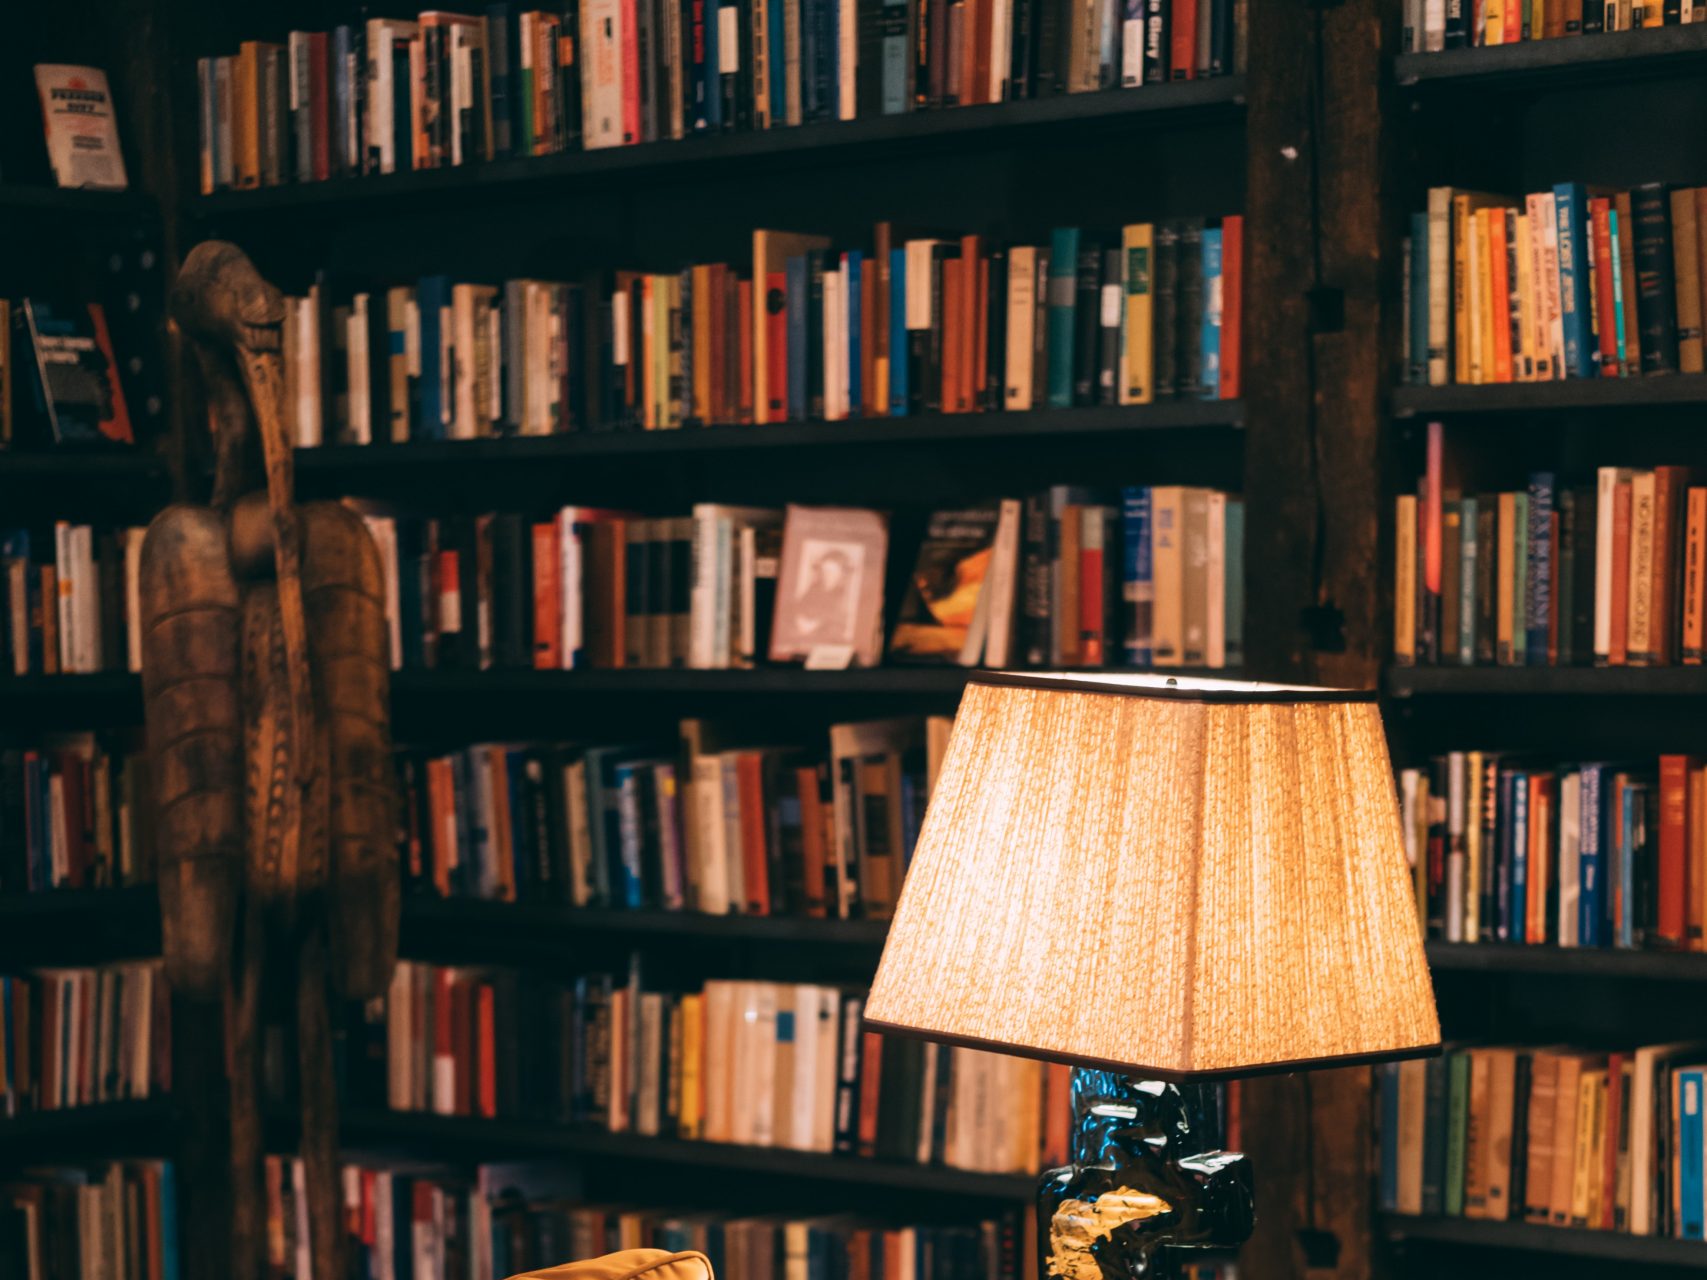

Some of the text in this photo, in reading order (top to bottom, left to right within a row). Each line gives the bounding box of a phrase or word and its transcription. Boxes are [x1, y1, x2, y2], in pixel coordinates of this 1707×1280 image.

[1146, 16, 1162, 58] Glory
[1545, 247, 1559, 322] ETHIOPIA
[1559, 231, 1572, 269] LOST
[1535, 487, 1551, 625] ALEX BORAINE
[1634, 494, 1651, 645] NO NEUTRAL GROUND
